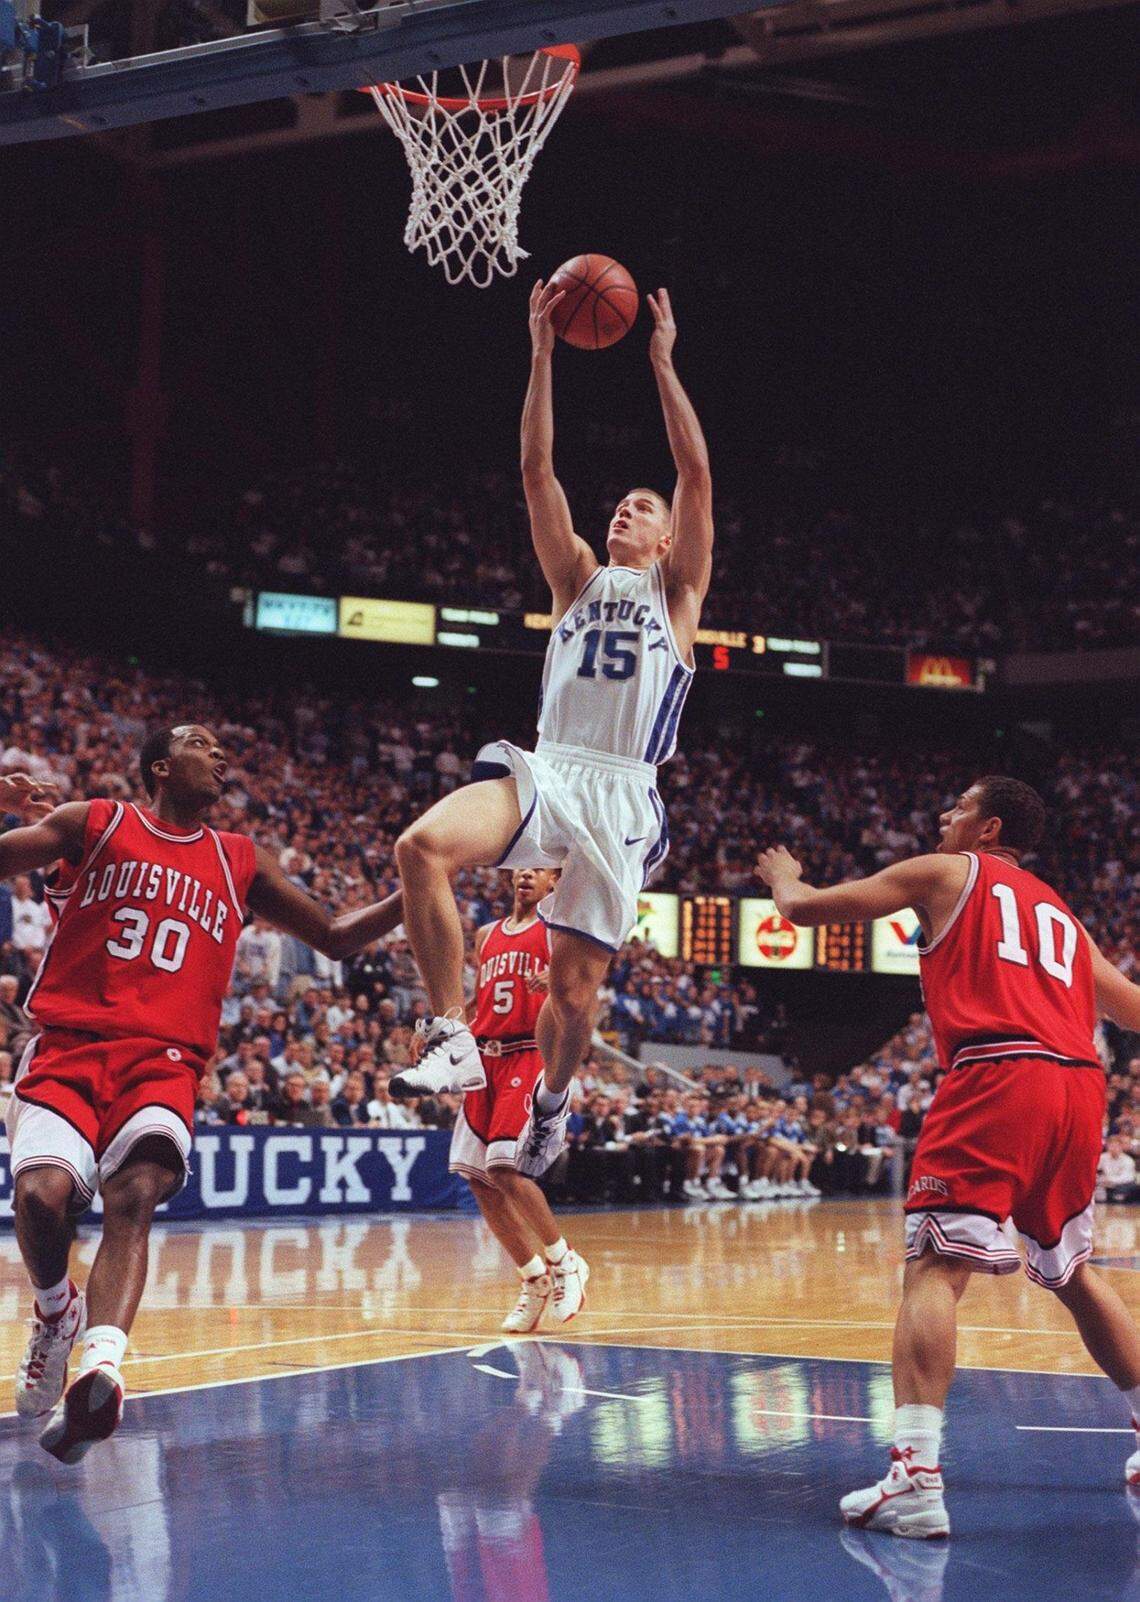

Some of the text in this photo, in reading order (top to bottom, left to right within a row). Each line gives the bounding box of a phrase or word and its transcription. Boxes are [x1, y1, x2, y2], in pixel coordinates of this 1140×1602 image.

[556, 599, 669, 652] KENTUCKY
[577, 629, 640, 680] 15
[80, 861, 228, 944] LOUISVILLE
[106, 906, 190, 973] 30
[992, 883, 1077, 989] 10
[480, 951, 550, 988] OUISVILL
[493, 980, 515, 1014] 5
